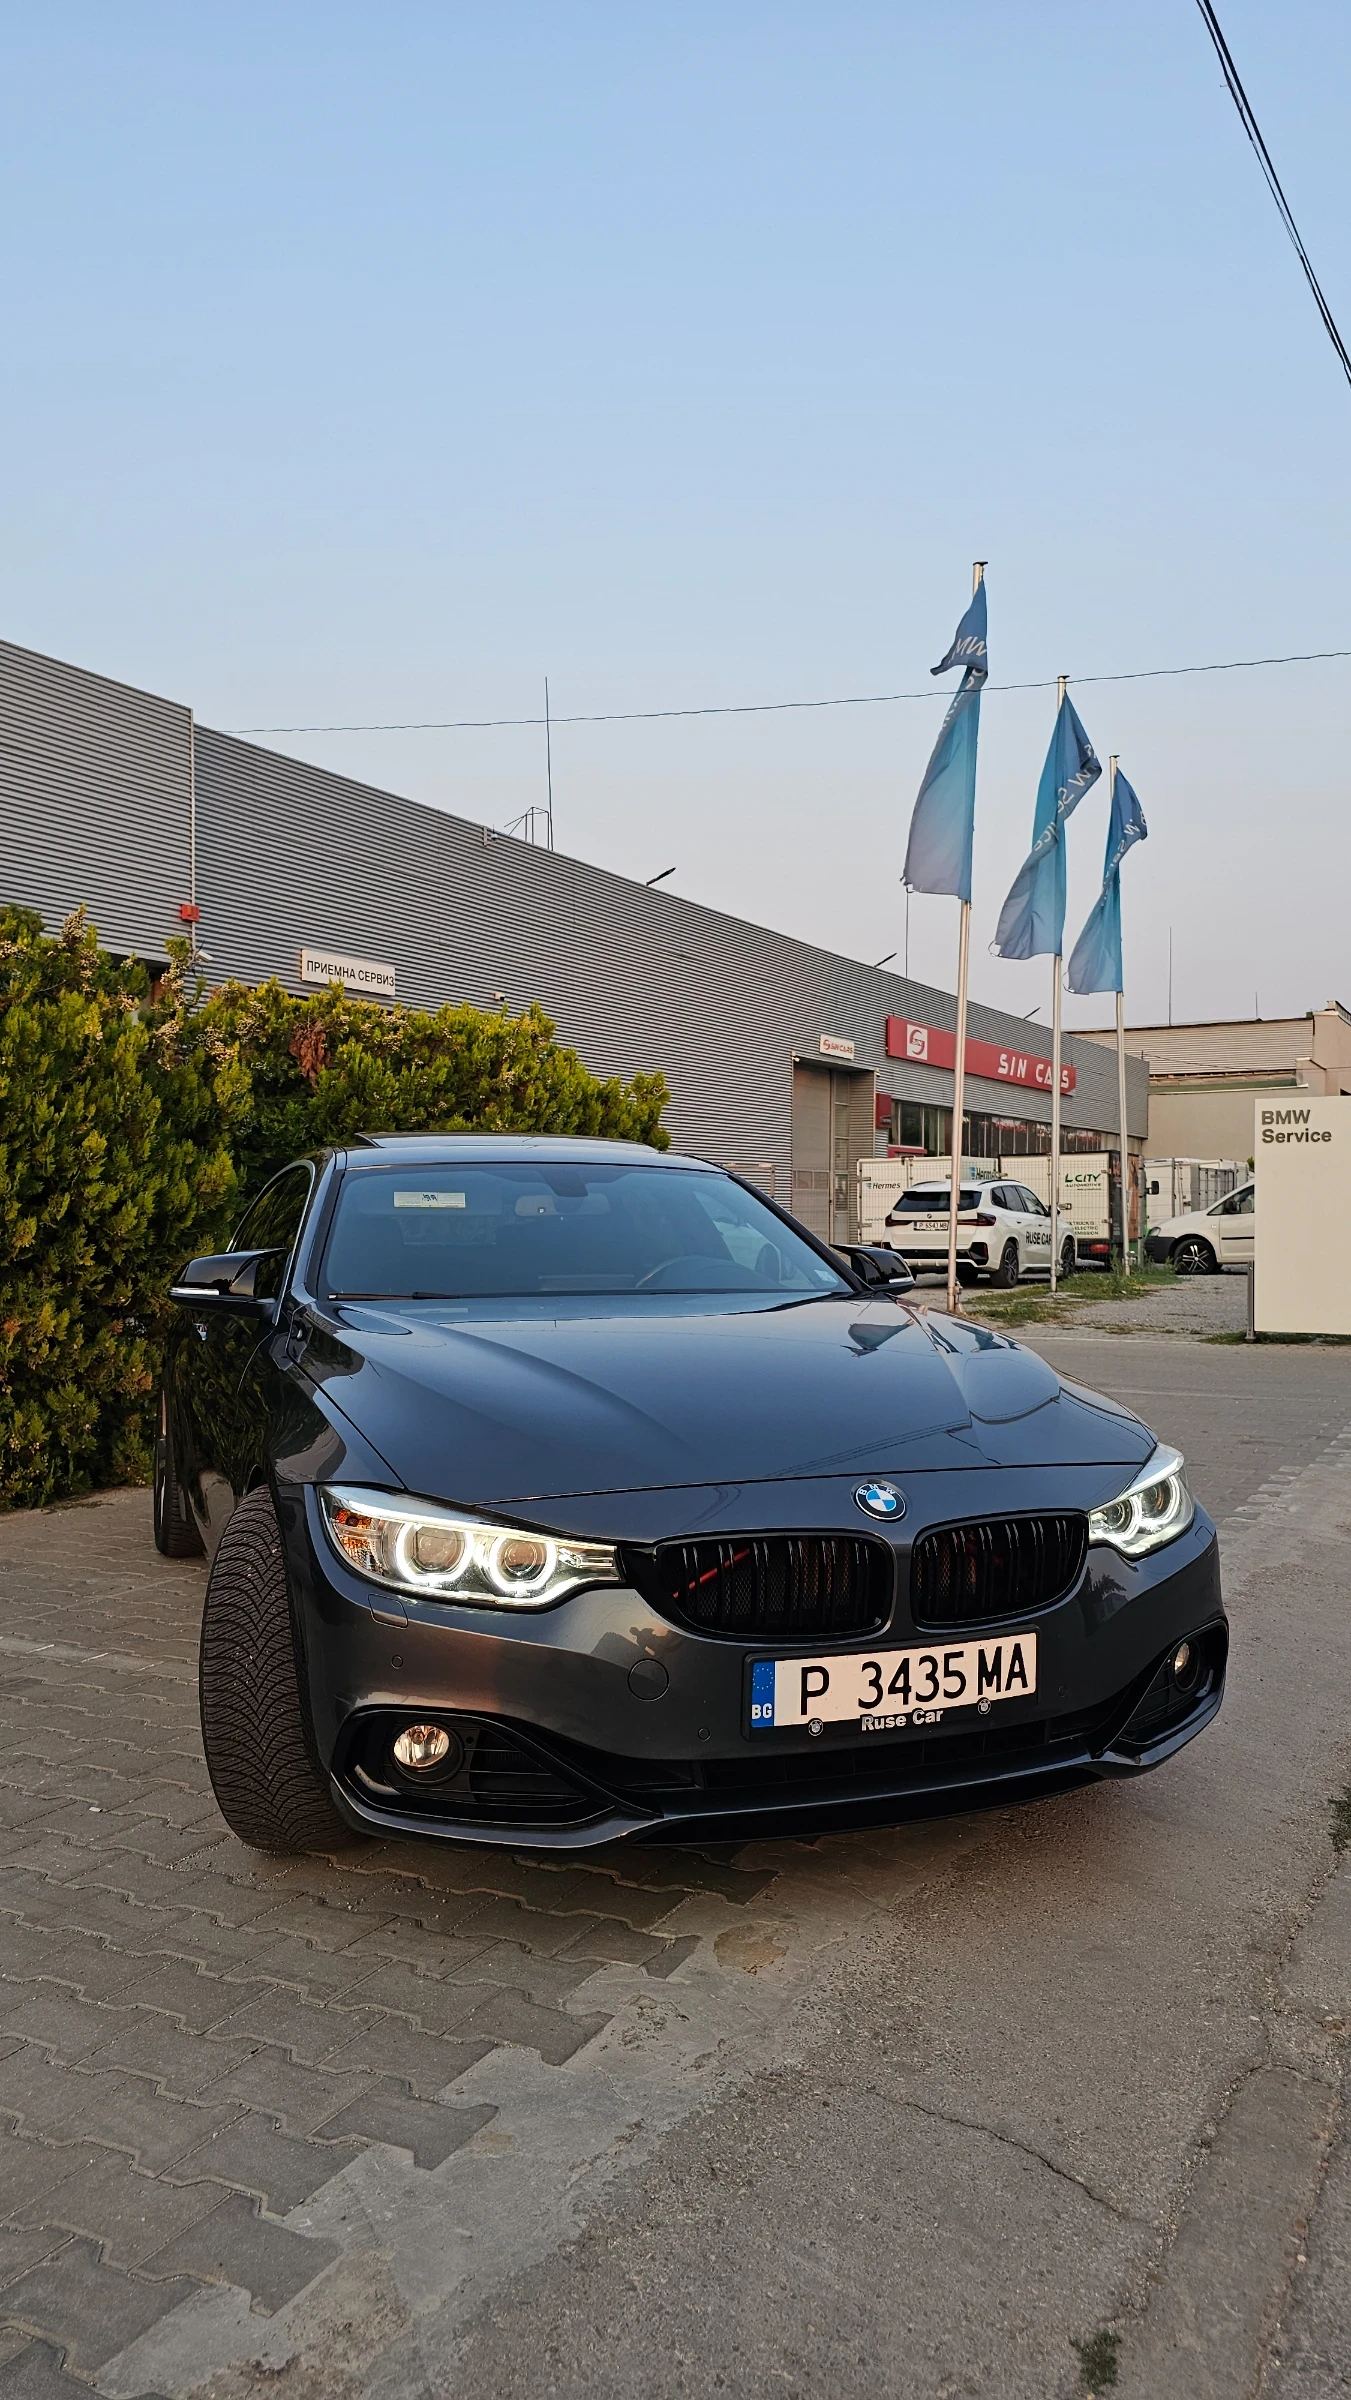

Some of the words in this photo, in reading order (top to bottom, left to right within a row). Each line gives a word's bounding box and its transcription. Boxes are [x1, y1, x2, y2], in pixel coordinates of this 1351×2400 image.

[306, 960, 356, 980] ПРИЕМНА
[358, 970, 395, 987] СЕРВИЗ
[997, 1053, 1028, 1079] SIN
[1035, 1063, 1069, 1089] CAS
[1261, 1109, 1311, 1126] BMW
[1261, 1127, 1332, 1144] Service
[1025, 1231, 1041, 1245] RUSE
[858, 1483, 896, 1496] BMW
[800, 1665, 830, 1716] P
[857, 1650, 967, 1710] 3435
[977, 1642, 1029, 1697] MA
[751, 1703, 773, 1720] BG
[861, 1714, 907, 1732] Ruse
[912, 1707, 944, 1726] Car
